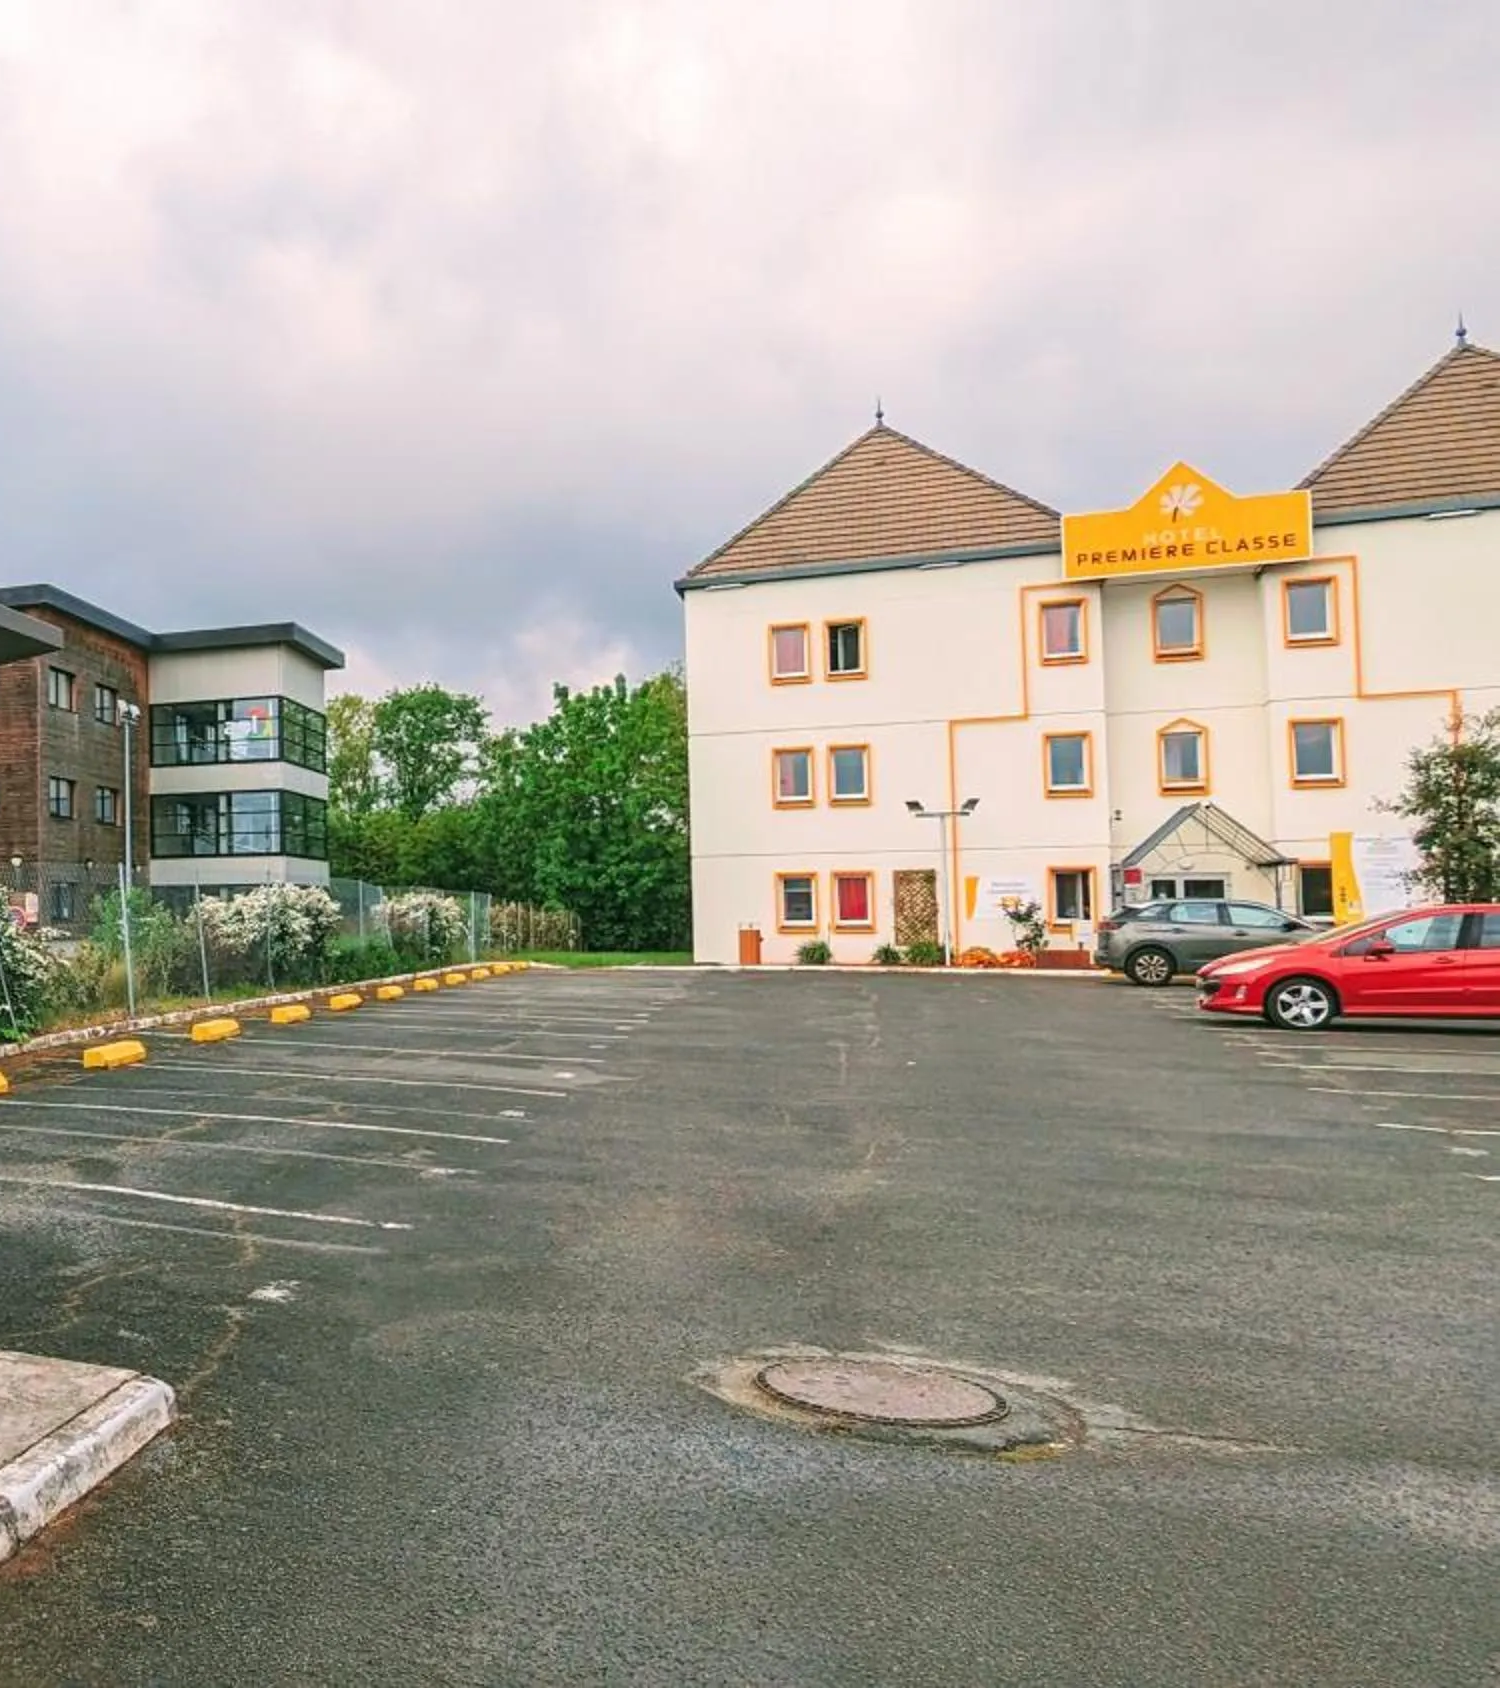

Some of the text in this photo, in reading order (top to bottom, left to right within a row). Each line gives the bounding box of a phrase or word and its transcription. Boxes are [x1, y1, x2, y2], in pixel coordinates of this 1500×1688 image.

[1076, 532, 1298, 567] PREMIERE CLASSE
[1142, 526, 1223, 546] HOTEL
